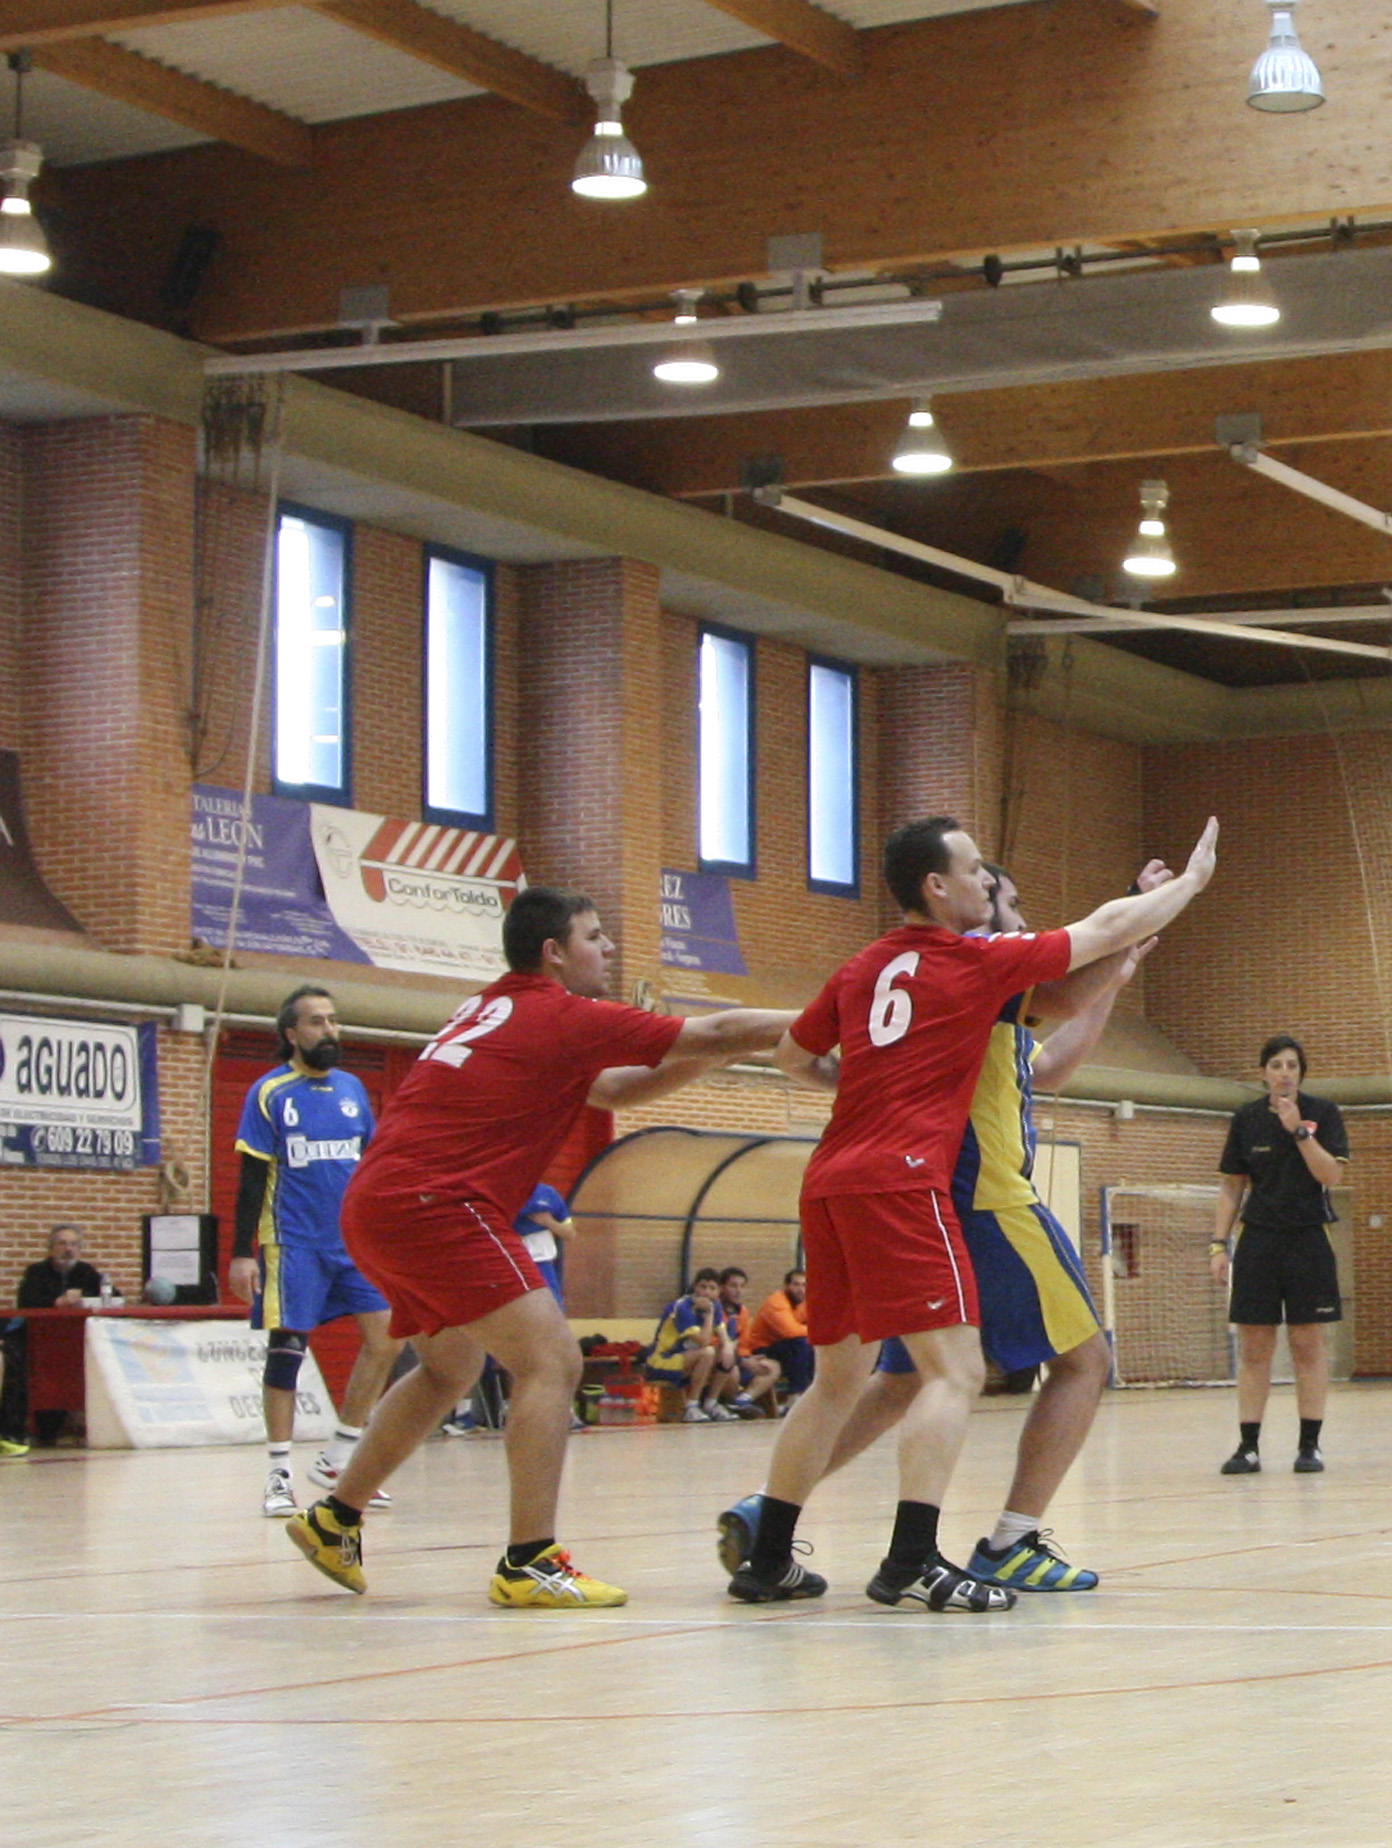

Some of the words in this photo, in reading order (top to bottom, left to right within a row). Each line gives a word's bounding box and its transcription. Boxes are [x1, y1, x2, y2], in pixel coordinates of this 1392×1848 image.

[868, 951, 920, 1046] 6
[284, 1097, 299, 1127] 6
[47, 1126, 73, 1152] 609
[75, 1127, 93, 1154] 22
[114, 1129, 134, 1156] 09
